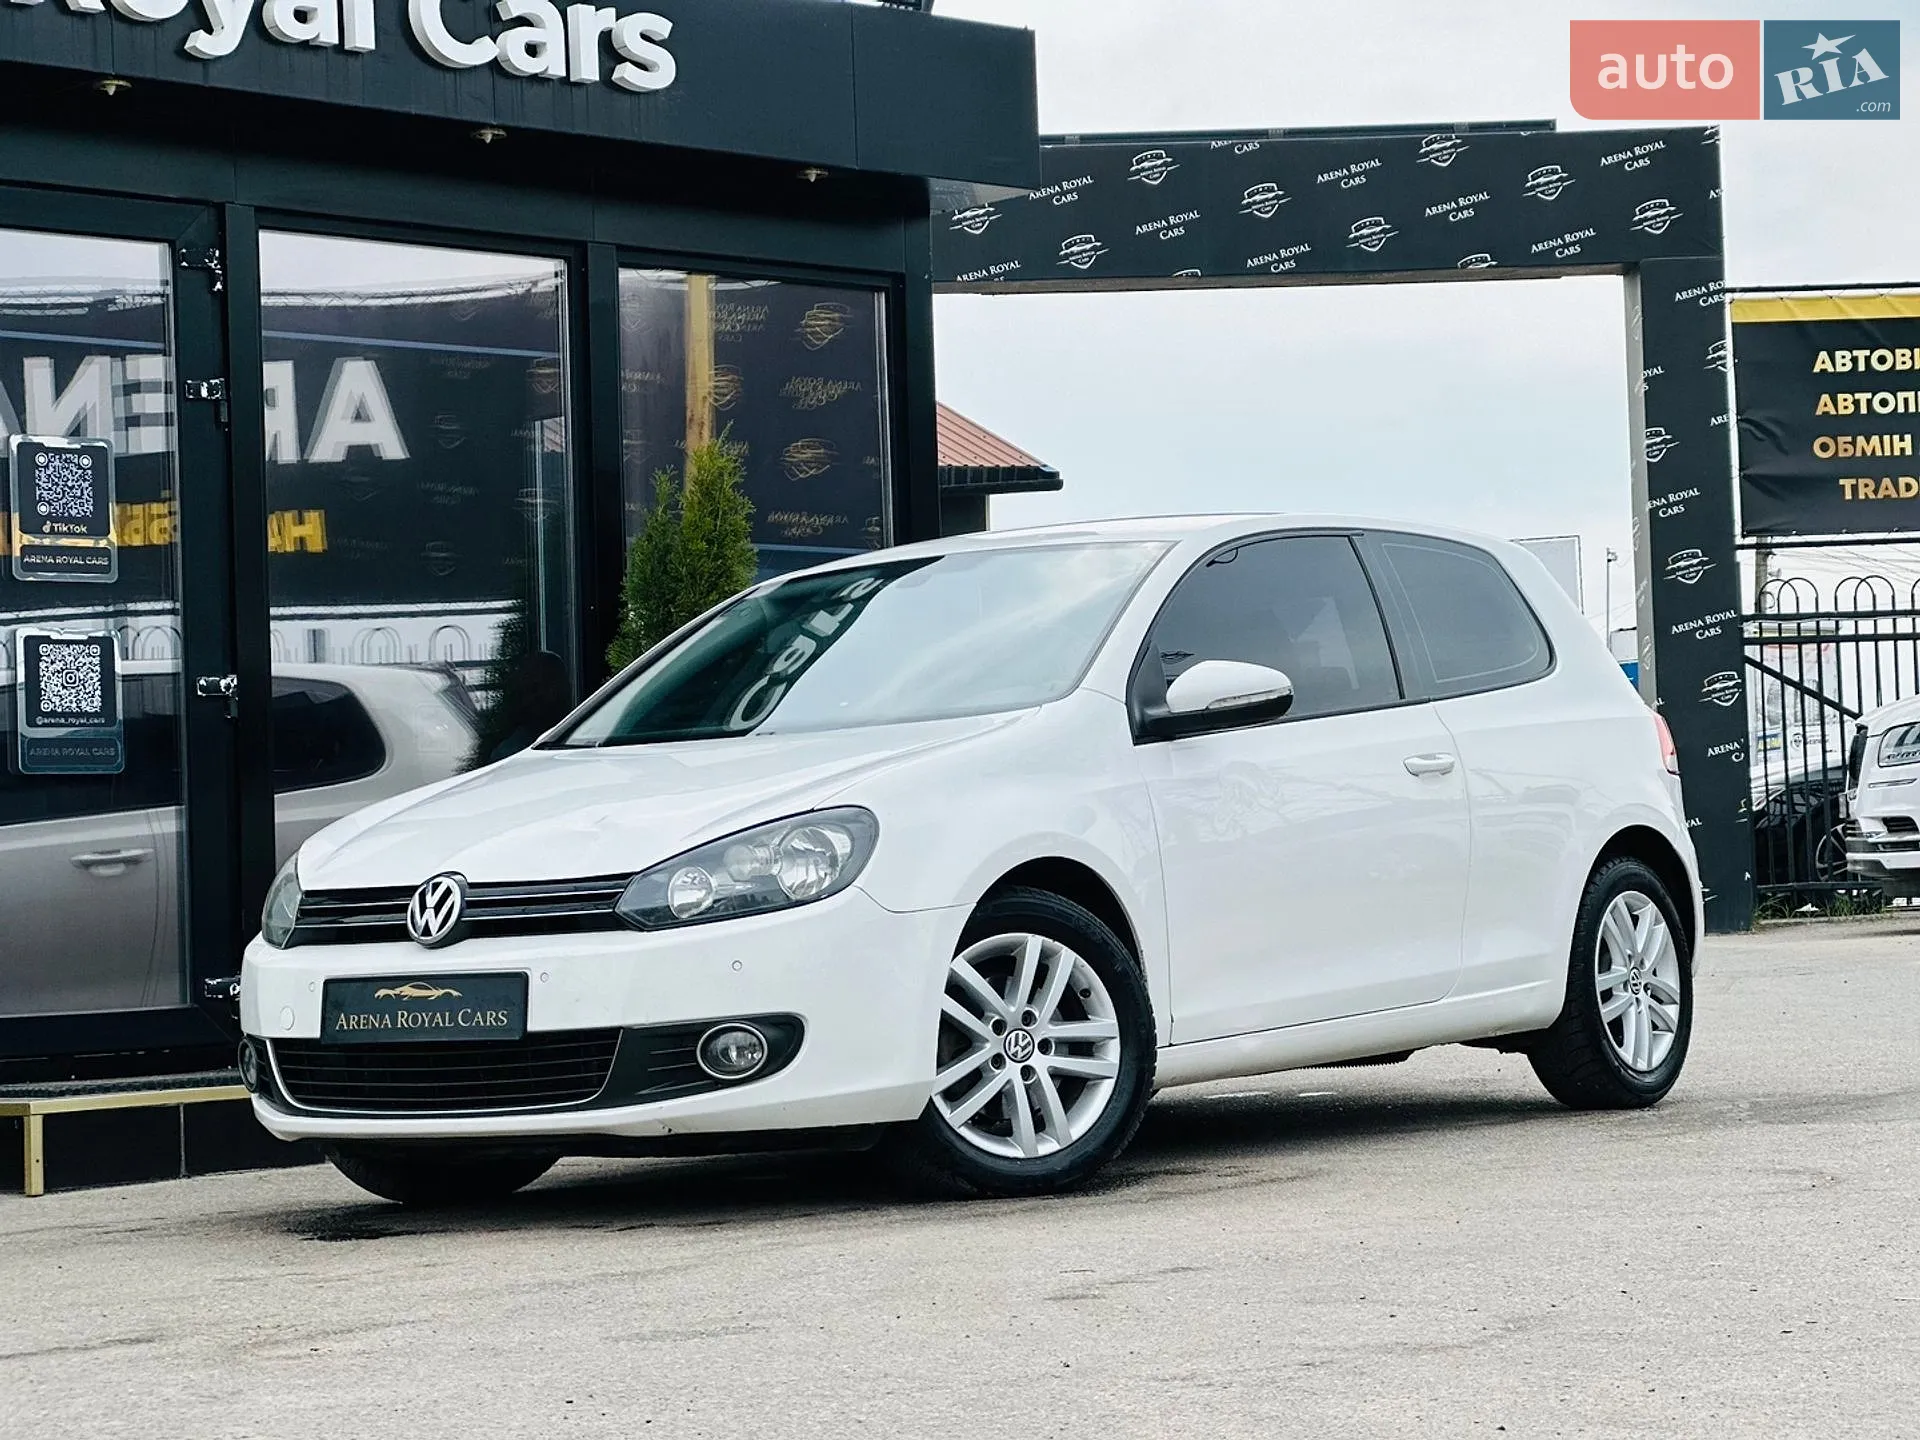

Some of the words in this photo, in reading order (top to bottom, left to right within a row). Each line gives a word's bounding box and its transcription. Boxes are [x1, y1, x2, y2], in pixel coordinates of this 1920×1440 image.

[408, 0, 676, 92] Cars
[1234, 140, 1260, 154] CARS
[1600, 150, 1634, 167] ARENA
[1634, 139, 1667, 156] ROYAL
[1316, 168, 1349, 184] ARENA
[1350, 158, 1382, 174] ROYAL
[1624, 157, 1651, 171] CARS
[1029, 184, 1061, 200] ARENA
[1062, 175, 1095, 191] ROYAL
[1340, 174, 1367, 189] CARS
[1052, 191, 1079, 206] CARS
[1424, 201, 1457, 217] ARENA
[1458, 191, 1491, 207] ROYAL
[1135, 220, 1168, 236] ARENA
[1168, 209, 1201, 226] ROYAL
[1449, 207, 1475, 222] CARS
[1159, 226, 1186, 240] CARS
[1530, 237, 1564, 254] ARENA
[1564, 227, 1596, 243] ROYAL
[1246, 252, 1279, 268] ARENA
[1279, 242, 1312, 258] ROYAL
[1555, 243, 1581, 258] CARS
[957, 269, 989, 281] ARENA
[989, 260, 1022, 275] ROYAL
[1270, 258, 1297, 273] CARS
[1674, 285, 1708, 302] ARENA
[1699, 292, 1726, 307] CARS
[1815, 391, 1920, 416] АВТОП
[1710, 413, 1729, 427] ARE
[1812, 434, 1913, 459] ОБМІН
[1668, 487, 1701, 503] ROYAL
[1839, 476, 1920, 500] TRAD
[1659, 503, 1685, 518] CARS
[52, 522, 88, 535] TikTok
[23, 553, 55, 564] ARENA
[56, 555, 84, 565] ROYAL
[86, 556, 109, 566] CARS
[1671, 618, 1704, 635] ARENA
[1704, 609, 1738, 625] ROYAL
[1695, 625, 1722, 640] CARS
[1707, 741, 1741, 758] ARENA
[335, 1012, 392, 1031] ARENA
[396, 1009, 454, 1029] ROYAL
[458, 1008, 508, 1028] CARS
